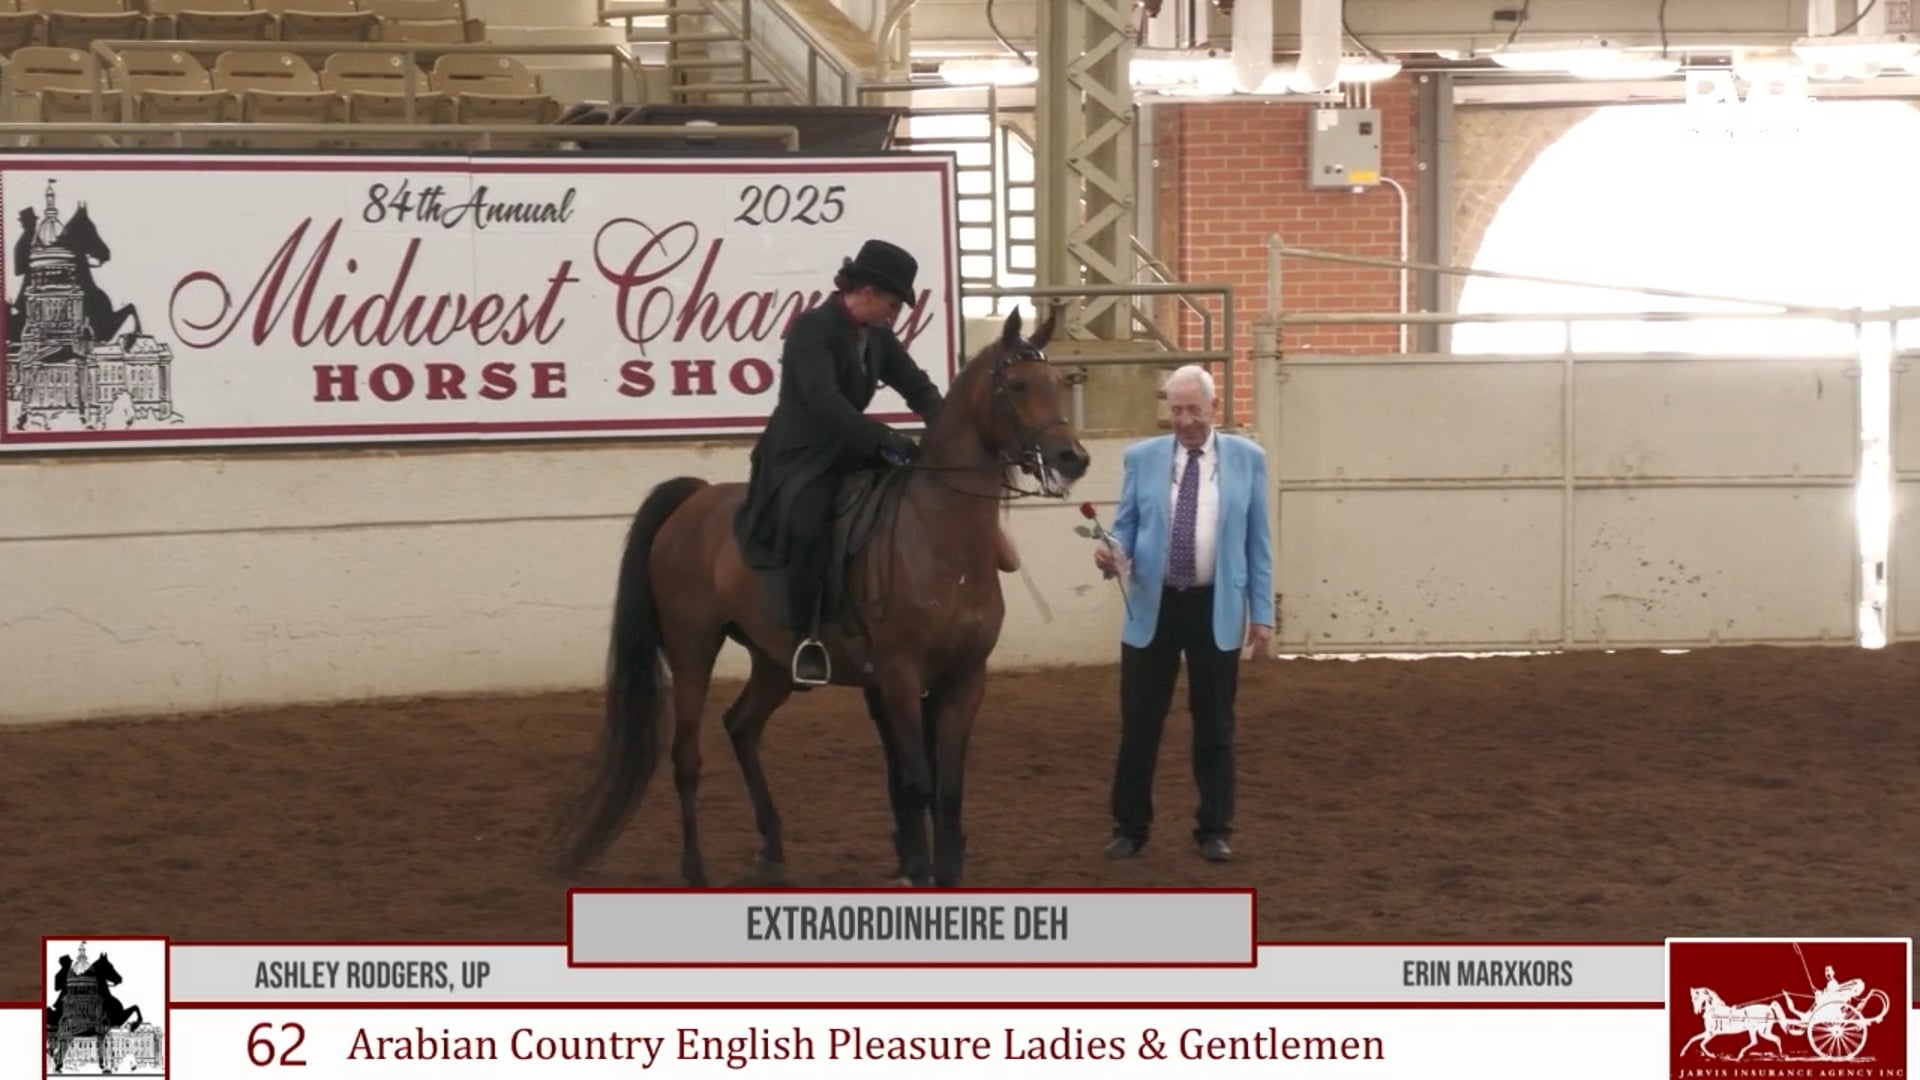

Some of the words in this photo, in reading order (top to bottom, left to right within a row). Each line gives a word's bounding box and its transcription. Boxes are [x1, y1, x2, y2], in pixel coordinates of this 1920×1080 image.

[363, 178, 445, 224] 84th
[441, 185, 577, 230] Annual
[734, 184, 847, 226] 2025
[169, 216, 580, 350] Midwest
[593, 217, 934, 389] Chary
[313, 361, 567, 402] HORSE
[617, 357, 780, 398] SHO
